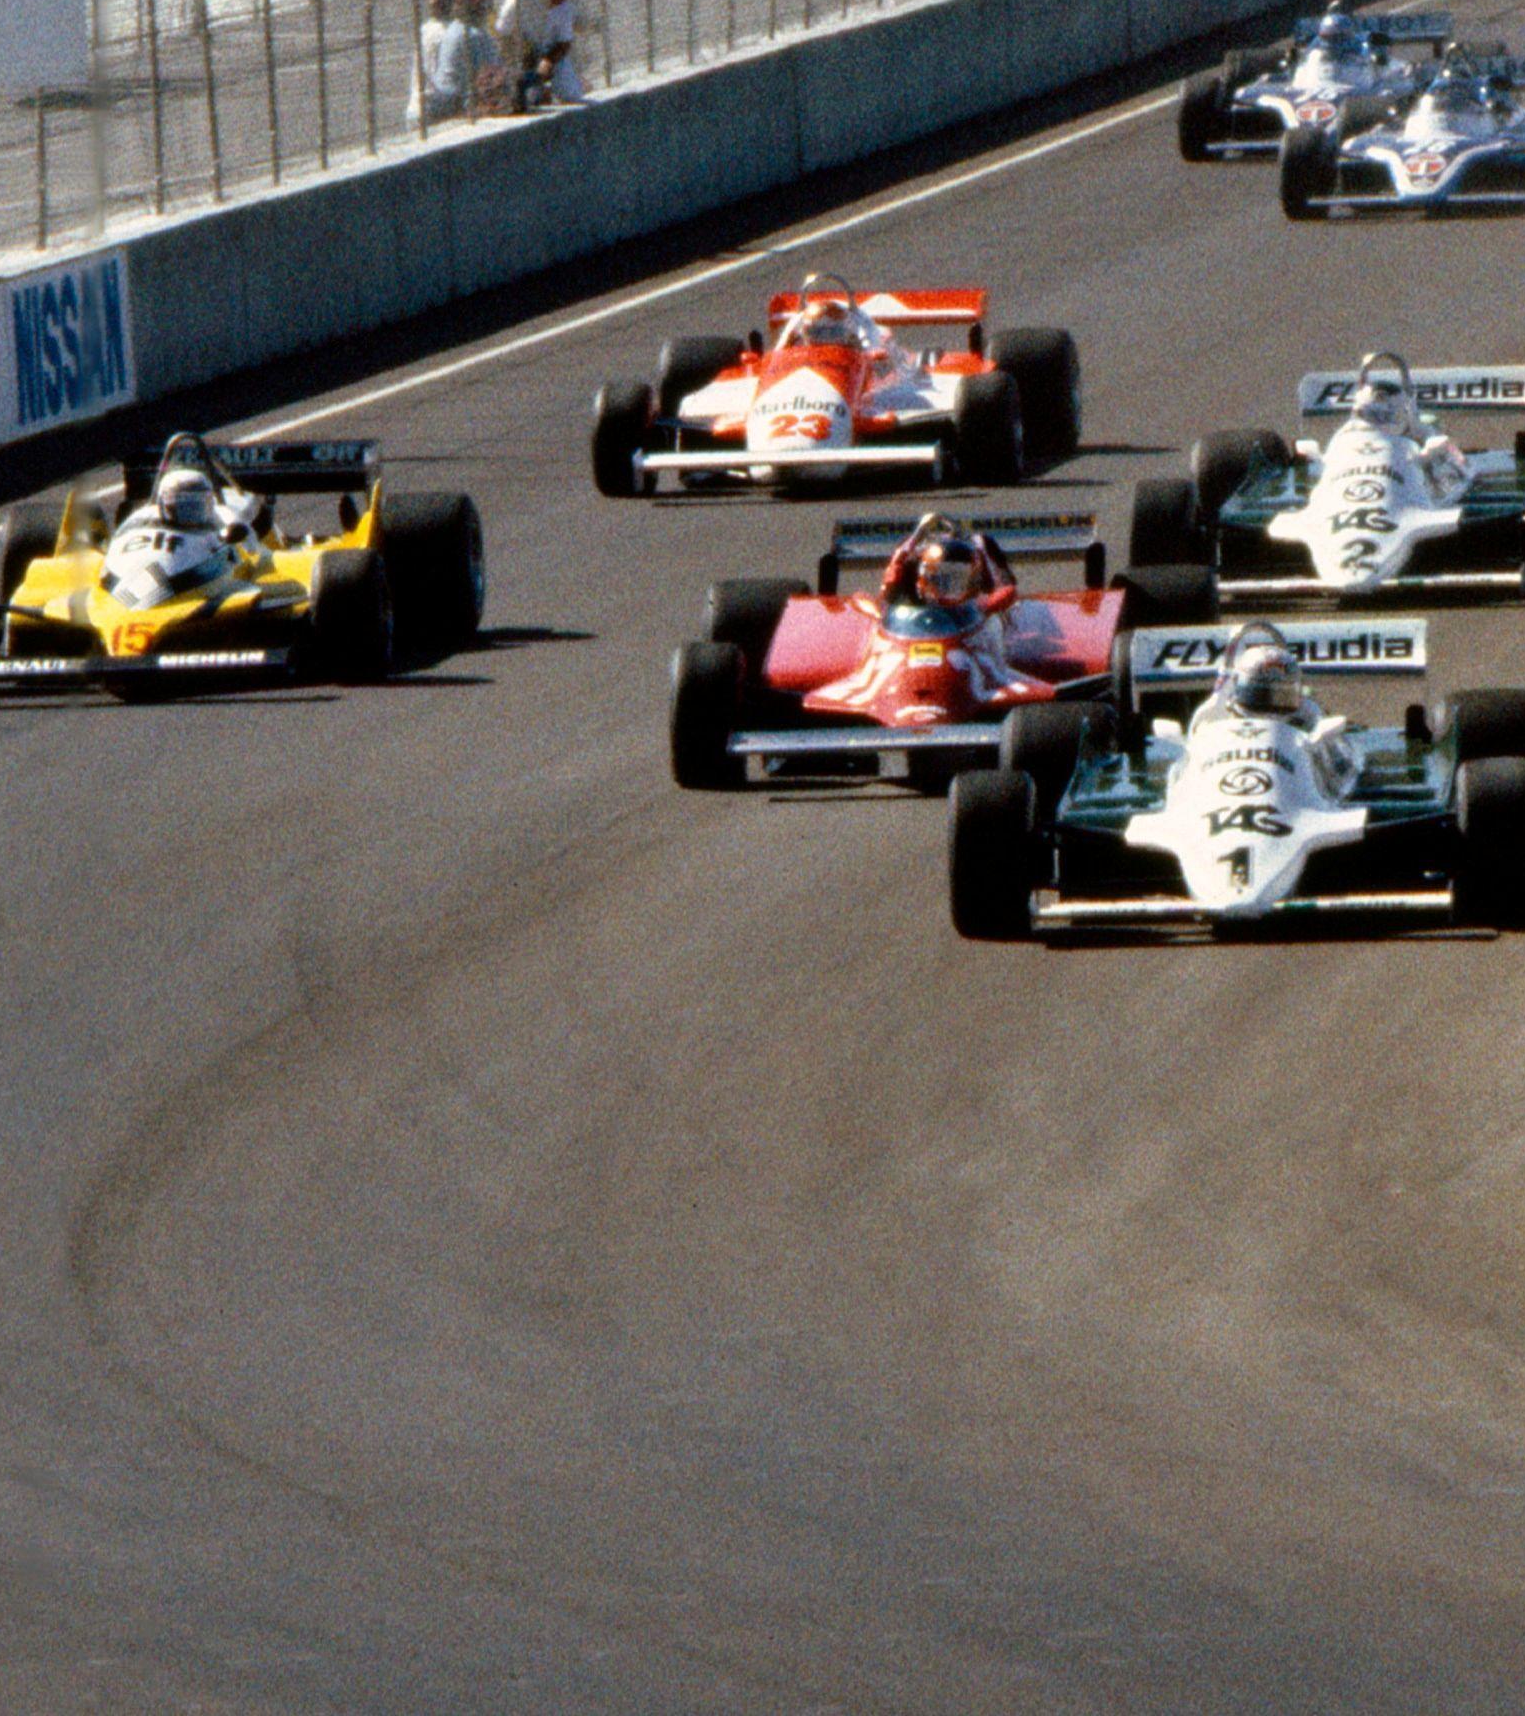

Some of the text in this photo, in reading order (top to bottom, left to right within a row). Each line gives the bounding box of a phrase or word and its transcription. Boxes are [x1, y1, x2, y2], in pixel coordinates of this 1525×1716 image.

[1411, 378, 1525, 401] audia
[770, 414, 832, 441] 23
[1341, 539, 1381, 574] 2
[111, 622, 155, 655] 15
[1281, 634, 1414, 662] audia
[158, 650, 265, 669] MICHELIN
[1216, 844, 1251, 887] 1
